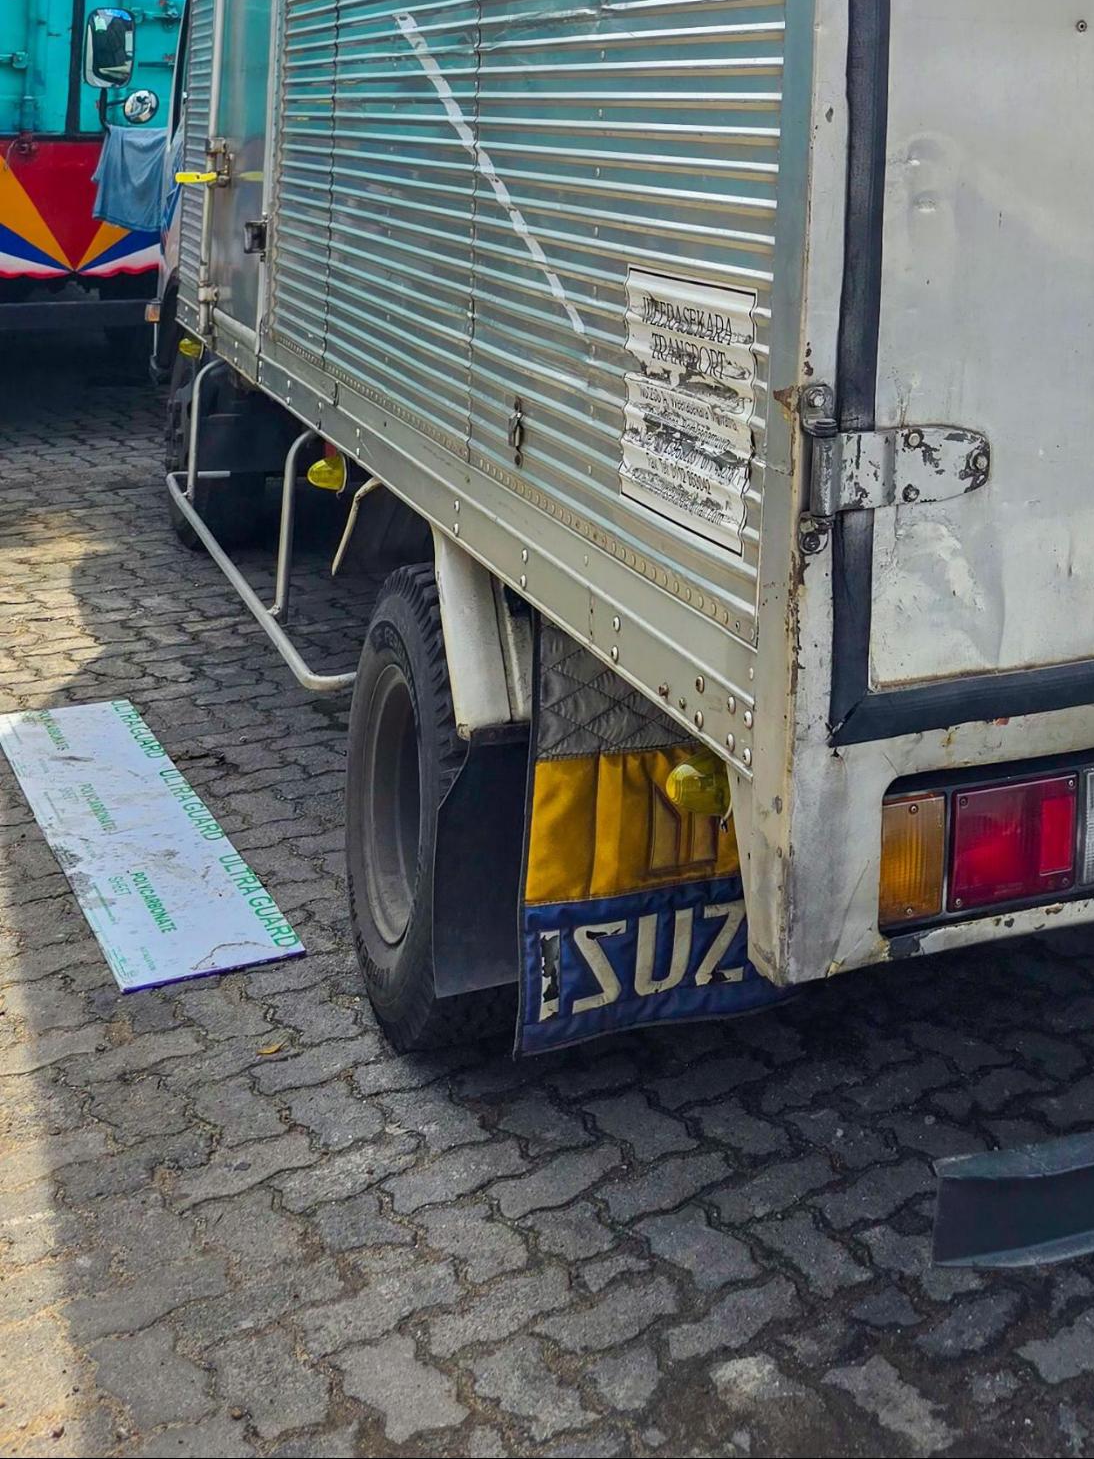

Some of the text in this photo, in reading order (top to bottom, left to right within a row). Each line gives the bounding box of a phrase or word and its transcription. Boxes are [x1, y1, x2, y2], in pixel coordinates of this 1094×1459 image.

[642, 297, 732, 345] WEERASEKARA
[651, 332, 726, 379] TRANSPORT
[129, 725, 168, 758] GUARD
[159, 769, 226, 841] ULTRA GUARD
[129, 871, 177, 934] POLYCARBONATE
[218, 853, 301, 949] ULTRA GUARD
